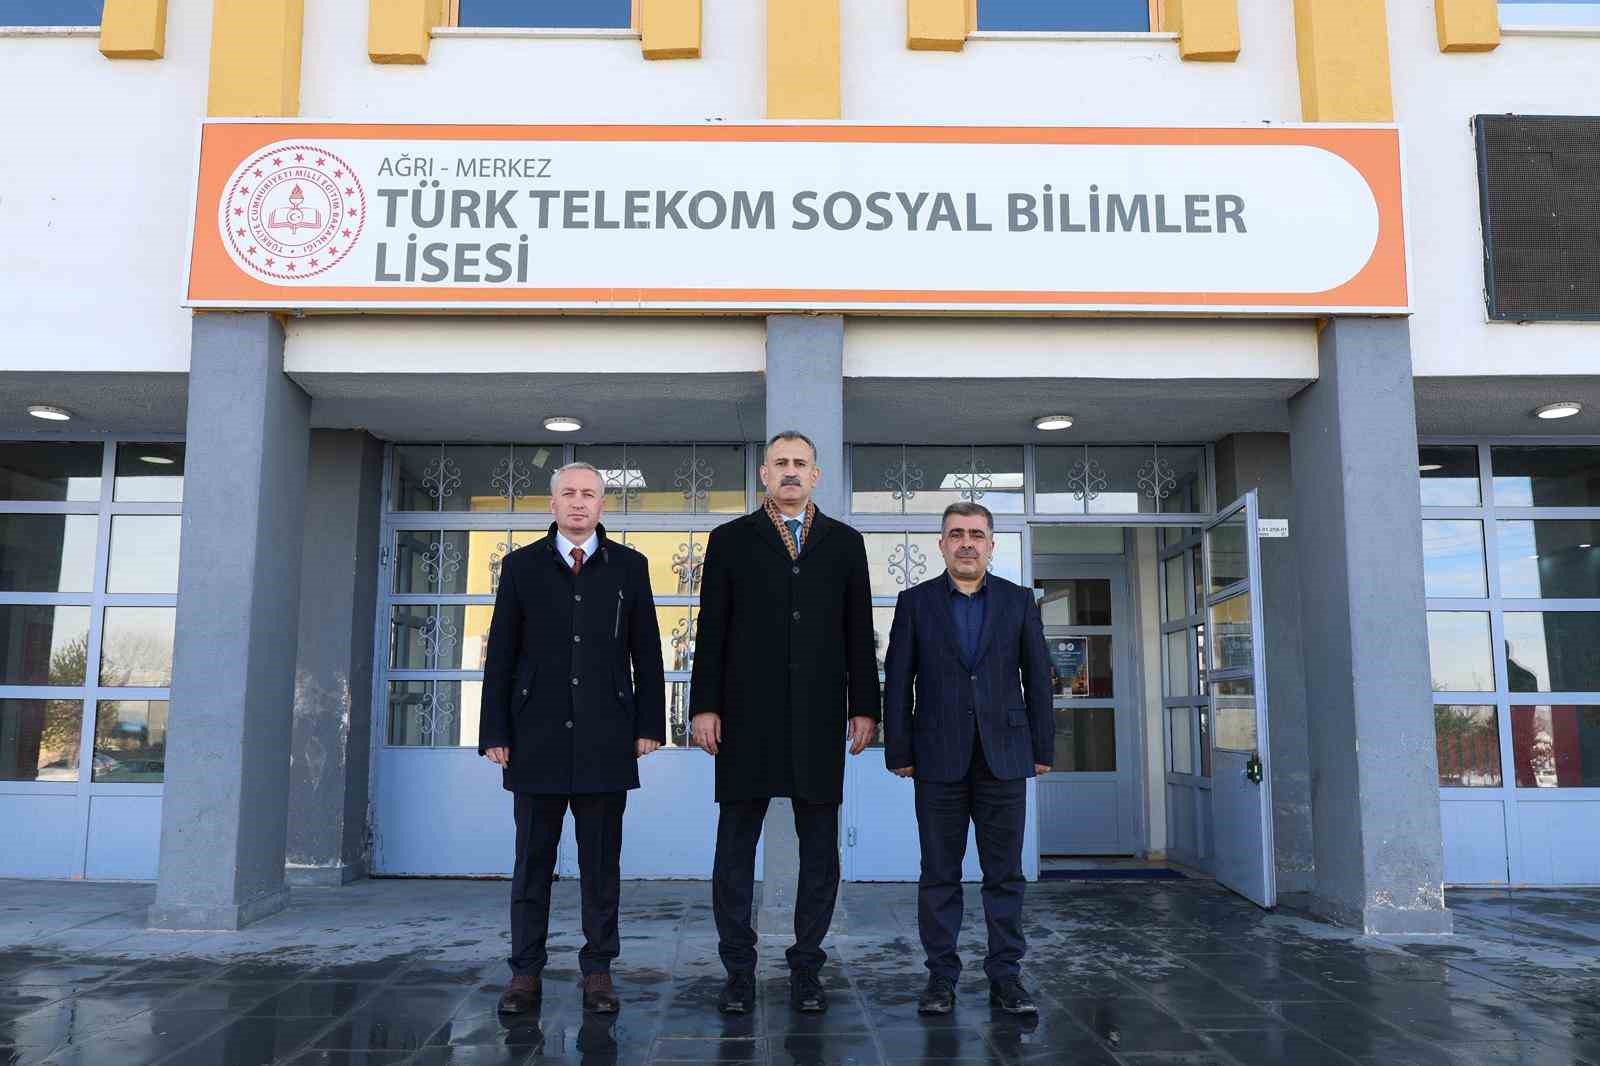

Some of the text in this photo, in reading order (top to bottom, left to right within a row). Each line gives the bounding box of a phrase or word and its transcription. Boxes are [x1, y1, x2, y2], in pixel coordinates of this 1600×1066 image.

[378, 155, 434, 178] AĞRI
[455, 159, 552, 178] MERKEZ
[377, 180, 1248, 234] TÜRK TELEKOM SOSYAL BİLİMLER
[374, 233, 529, 283] LİSESİ
